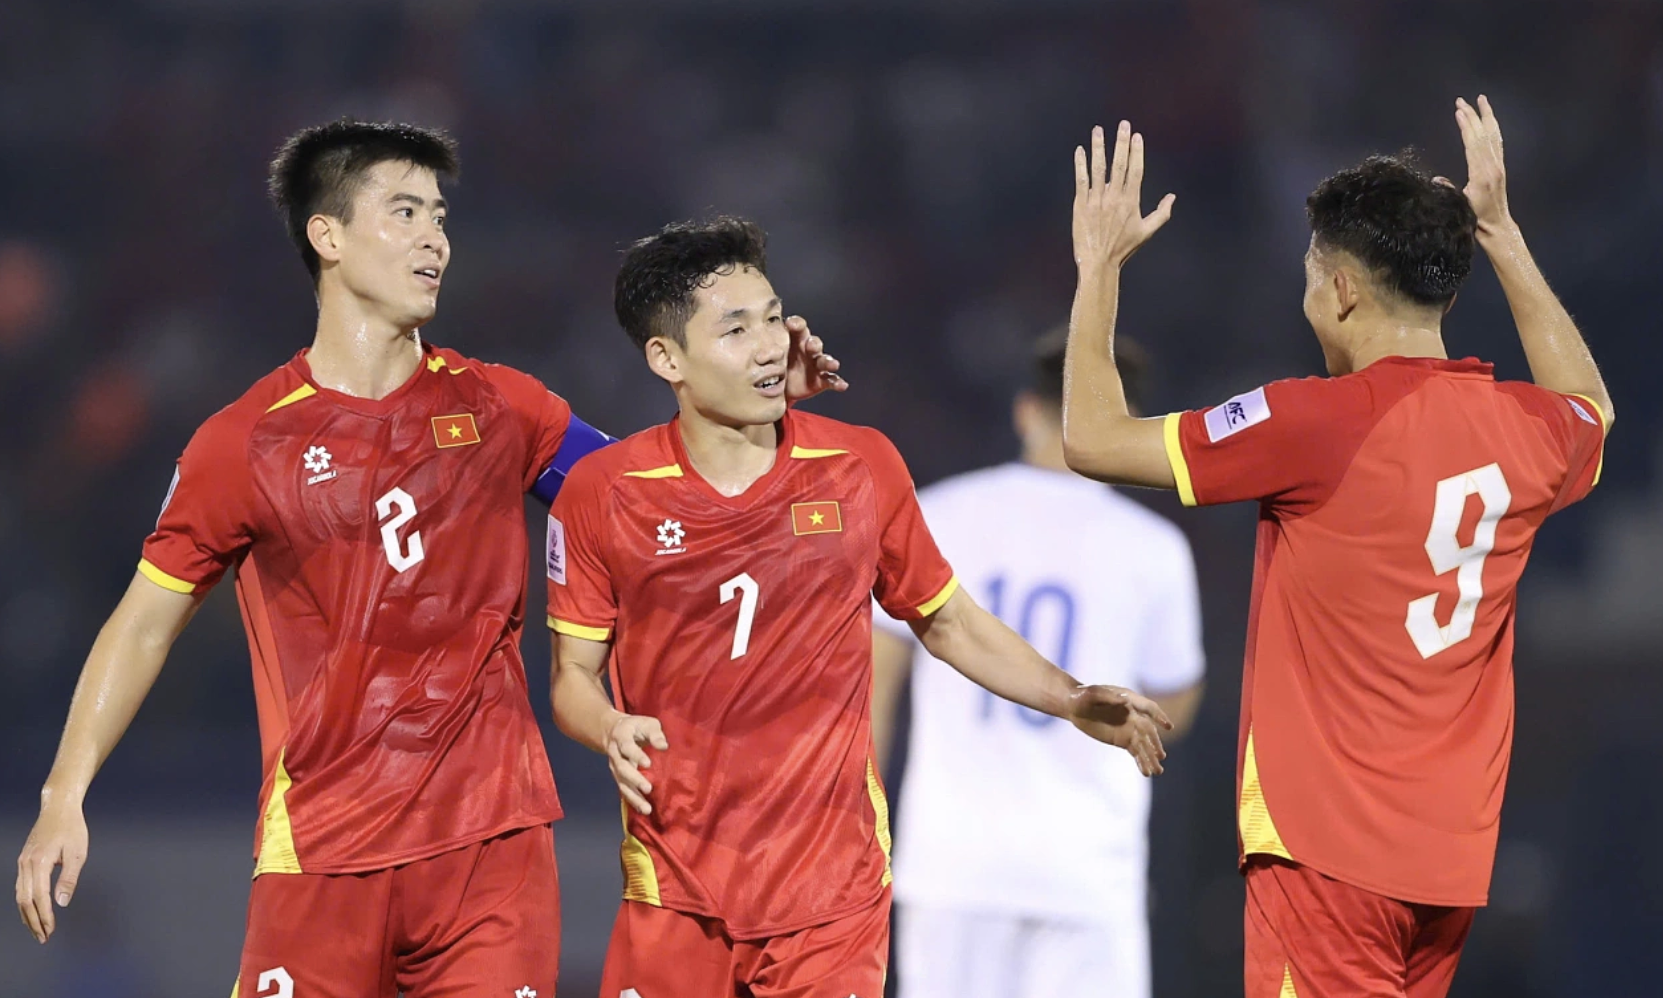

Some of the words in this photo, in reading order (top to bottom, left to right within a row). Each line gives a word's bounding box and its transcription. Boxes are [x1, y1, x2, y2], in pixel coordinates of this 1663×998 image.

[1228, 402, 1247, 424] AFC
[375, 486, 425, 573] 2
[1405, 462, 1511, 659] 9
[719, 572, 759, 660] 7
[980, 574, 1076, 728] 10
